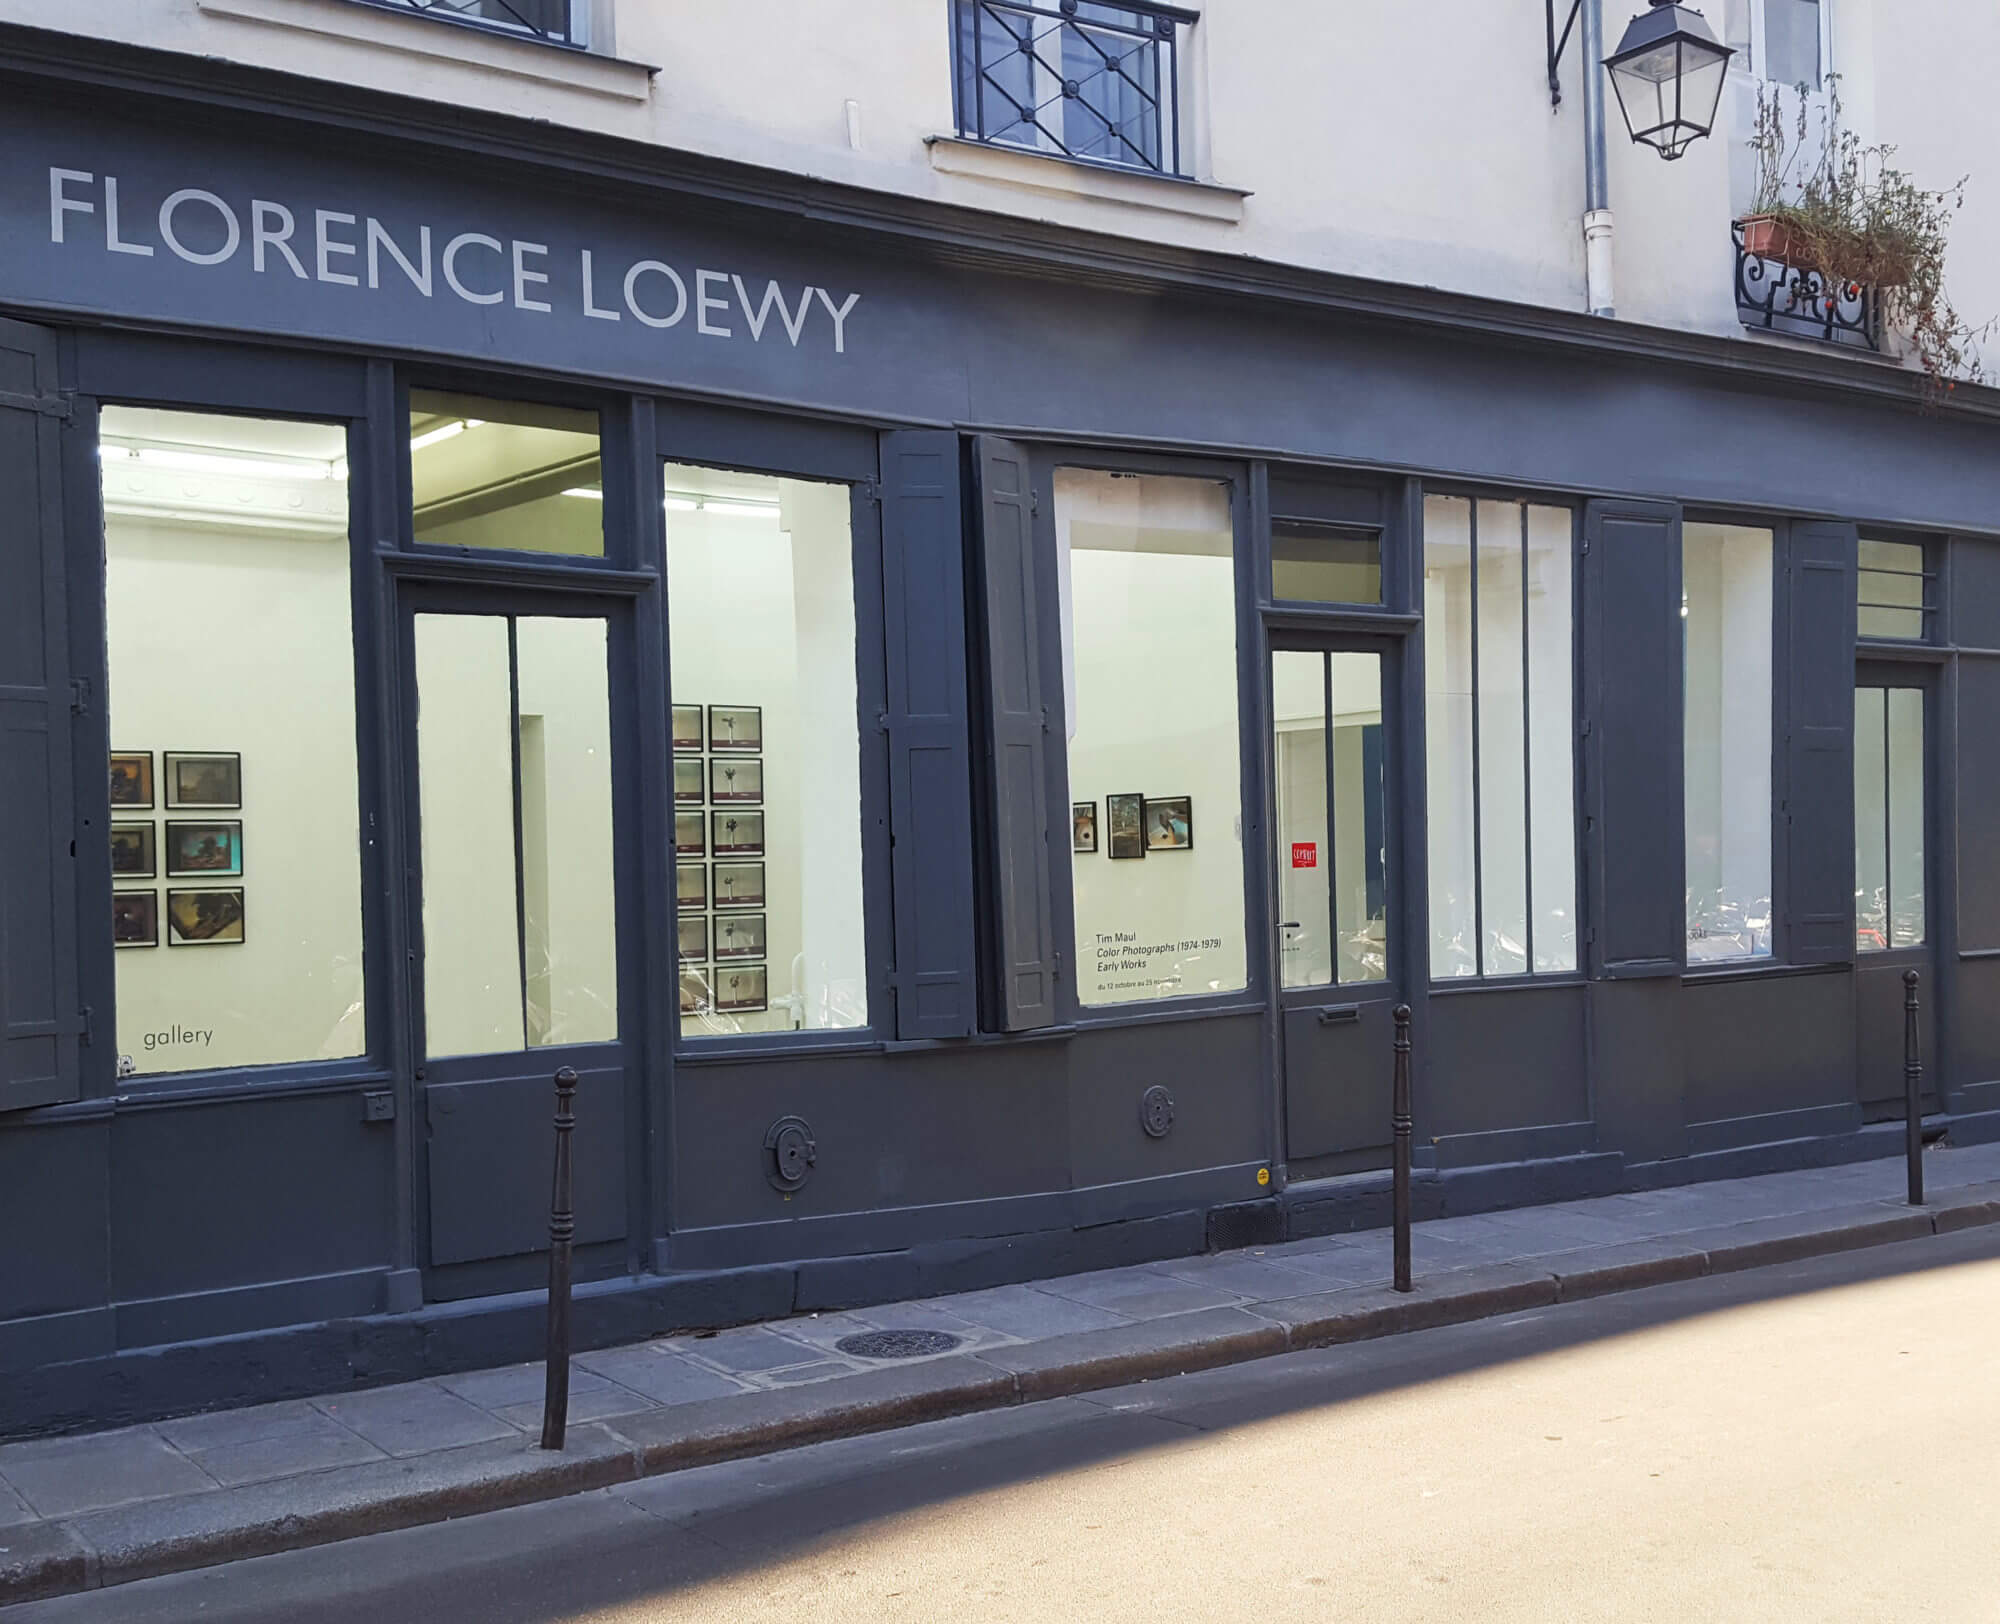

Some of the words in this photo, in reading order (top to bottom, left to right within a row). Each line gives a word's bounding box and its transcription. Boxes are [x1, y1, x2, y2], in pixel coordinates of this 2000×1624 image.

[49, 166, 552, 313] FLORENCE
[582, 249, 861, 353] LOEWY
[1096, 934, 1113, 944] Tim
[1115, 931, 1136, 942] Maul
[1097, 947, 1120, 958] Color
[1122, 942, 1175, 956] Photographs
[1177, 938, 1222, 953] (1974-1979)
[1097, 961, 1119, 973] Early
[1121, 959, 1147, 970] Works
[1107, 982, 1114, 990] 12
[143, 1024, 213, 1051] gallery
